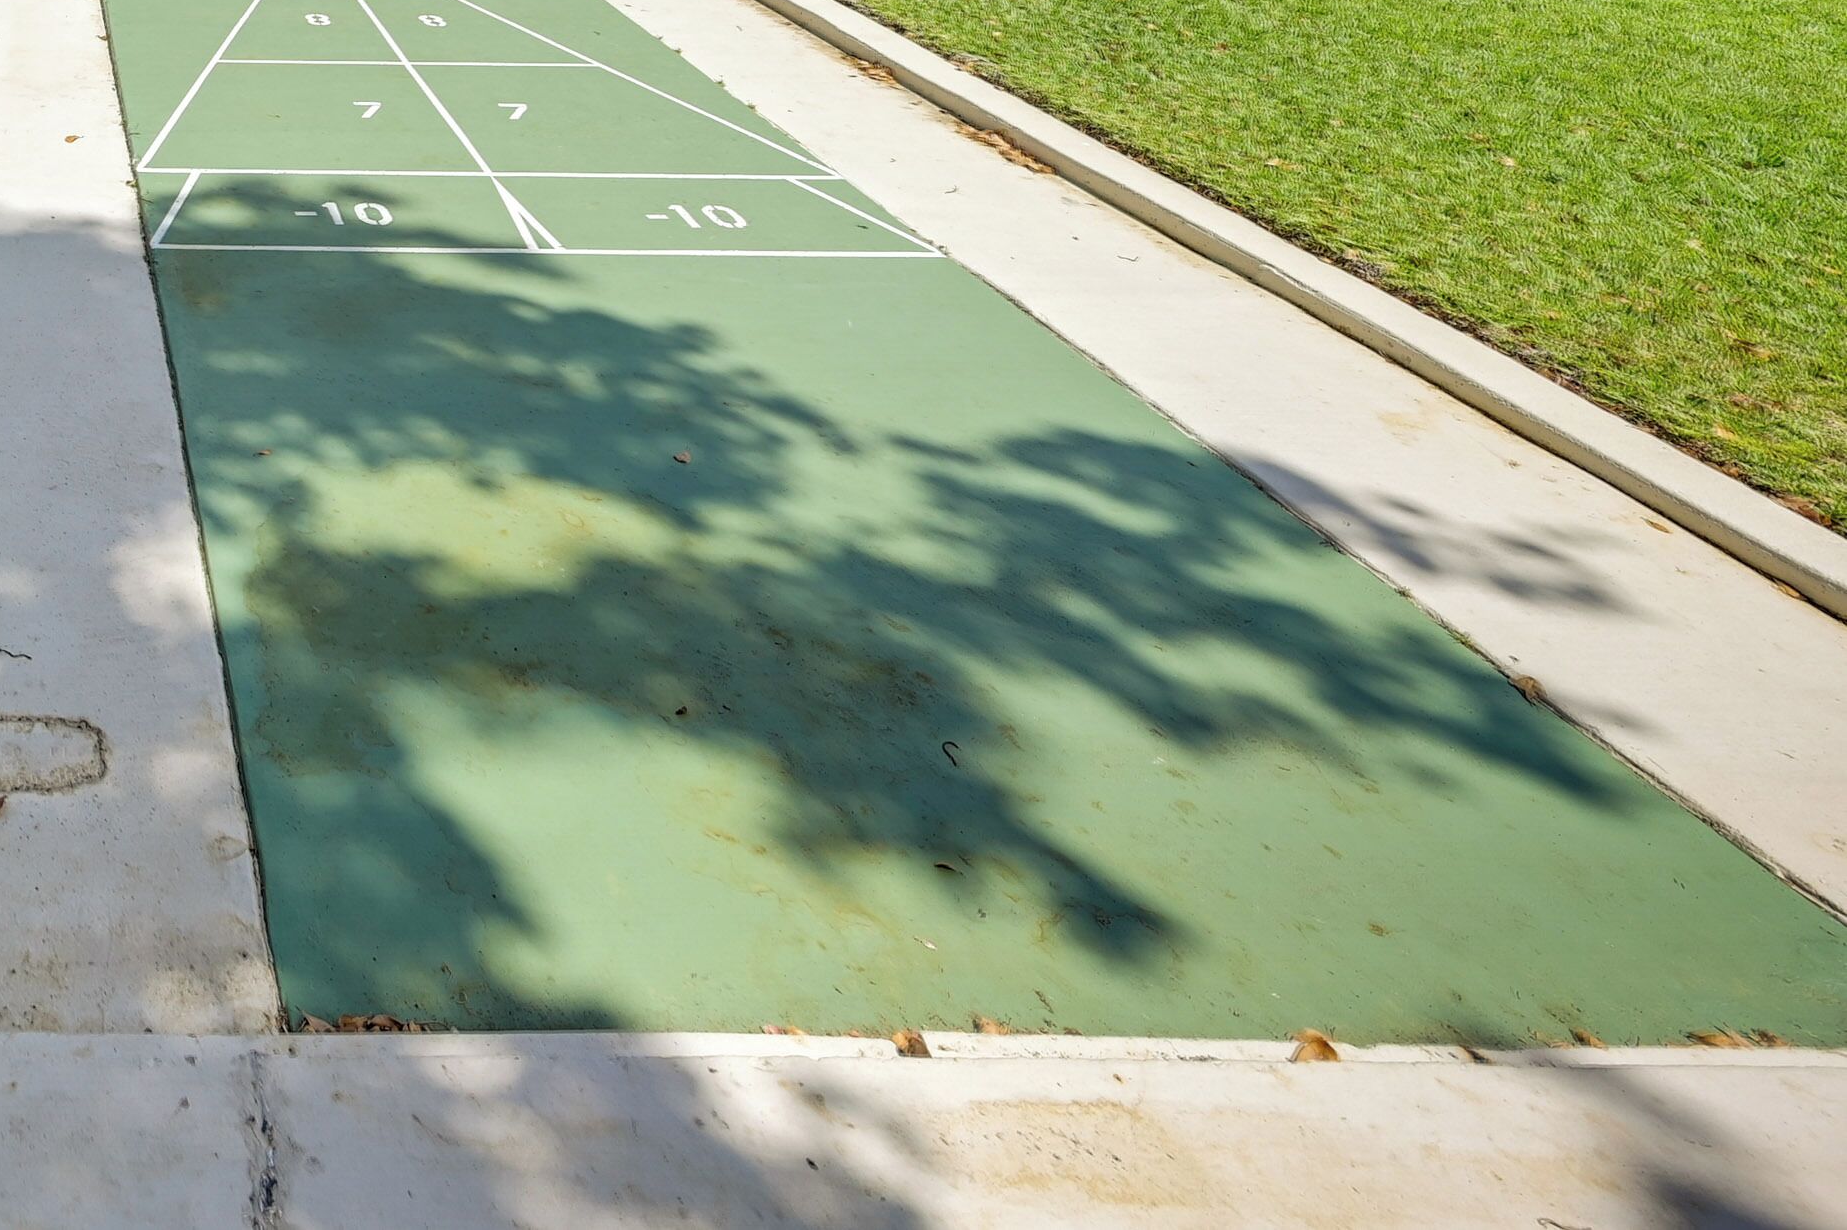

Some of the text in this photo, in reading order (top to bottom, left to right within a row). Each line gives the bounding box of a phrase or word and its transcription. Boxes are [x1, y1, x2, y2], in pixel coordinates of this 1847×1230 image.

[304, 13, 331, 26] 8
[417, 14, 447, 27] 8
[353, 101, 382, 119] 7
[497, 103, 528, 120] 7
[295, 202, 394, 227] -10
[645, 204, 747, 229] -10
